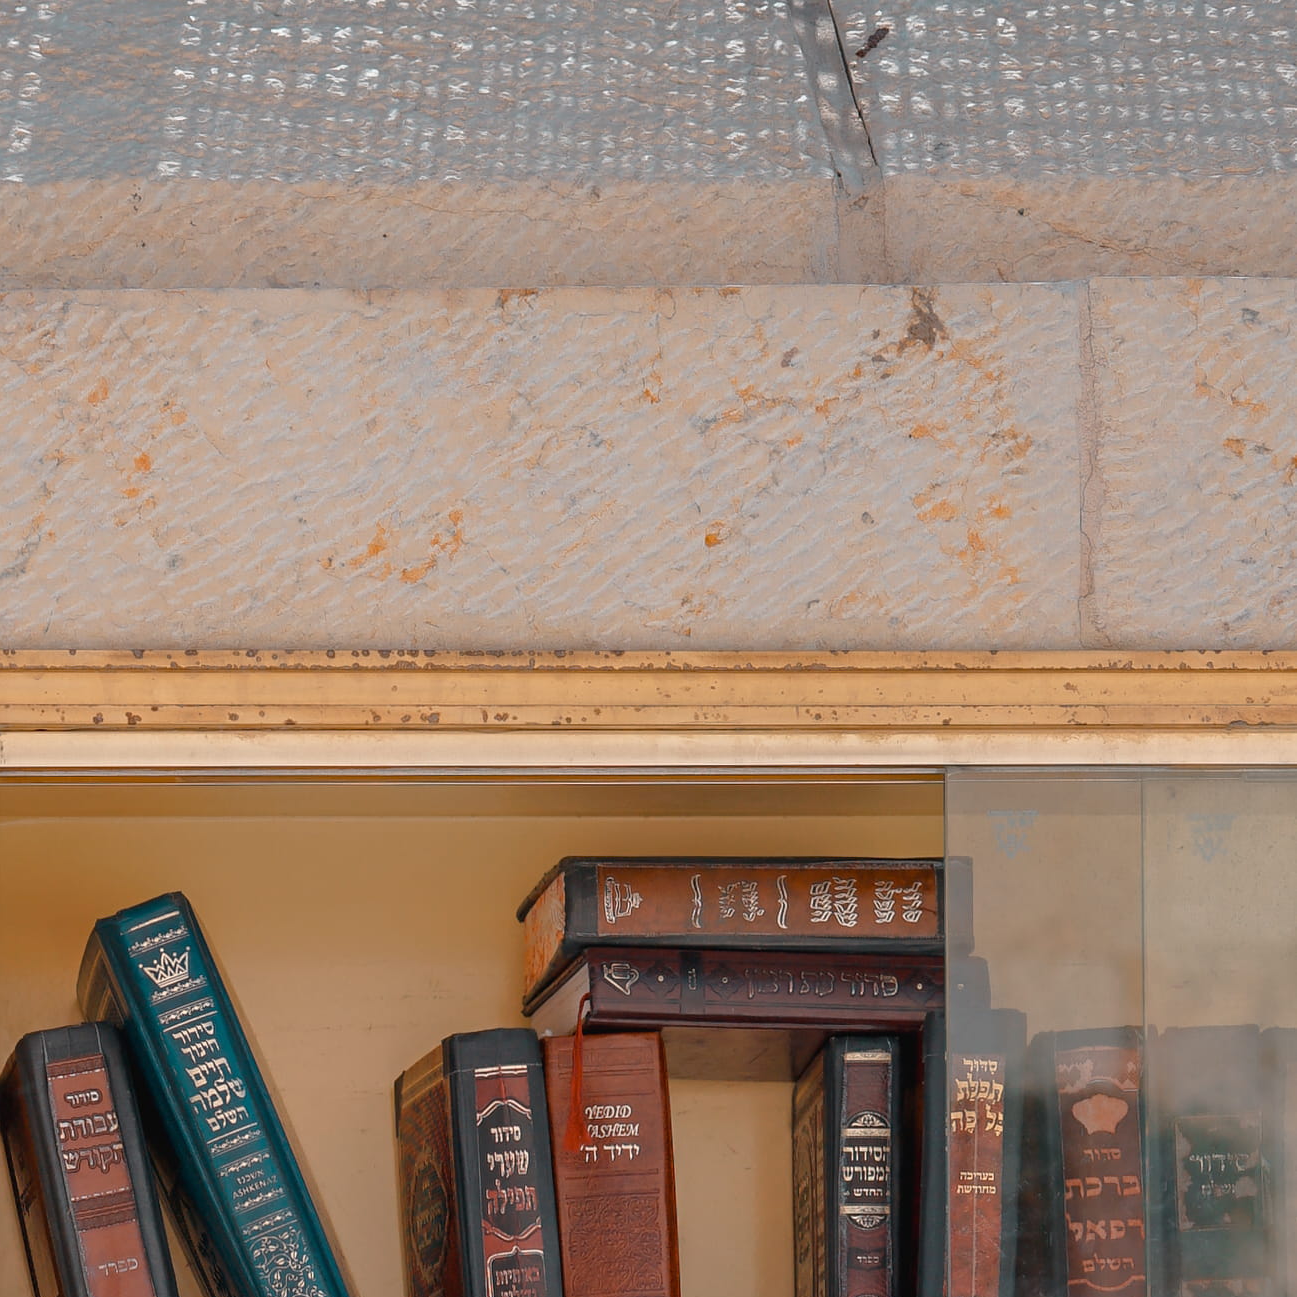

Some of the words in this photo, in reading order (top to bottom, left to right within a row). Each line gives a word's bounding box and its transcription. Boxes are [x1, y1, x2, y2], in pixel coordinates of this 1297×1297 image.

[173, 1021, 216, 1045] סידור
[182, 1037, 221, 1060] חינוך
[188, 1057, 232, 1088] חיים
[189, 1076, 248, 1115] שלמה
[206, 1106, 250, 1133] השלם
[585, 1105, 632, 1119] YEDID
[58, 1111, 118, 1142] עבודת
[490, 1125, 521, 1144] סידור
[604, 1145, 640, 1161] ידיד
[843, 1146, 891, 1161] הסידור
[843, 1165, 891, 1182] המפורש
[232, 1174, 278, 1200] ASHKENAZ
[853, 1186, 884, 1197] החדש
[1065, 1174, 1141, 1198] ברכת
